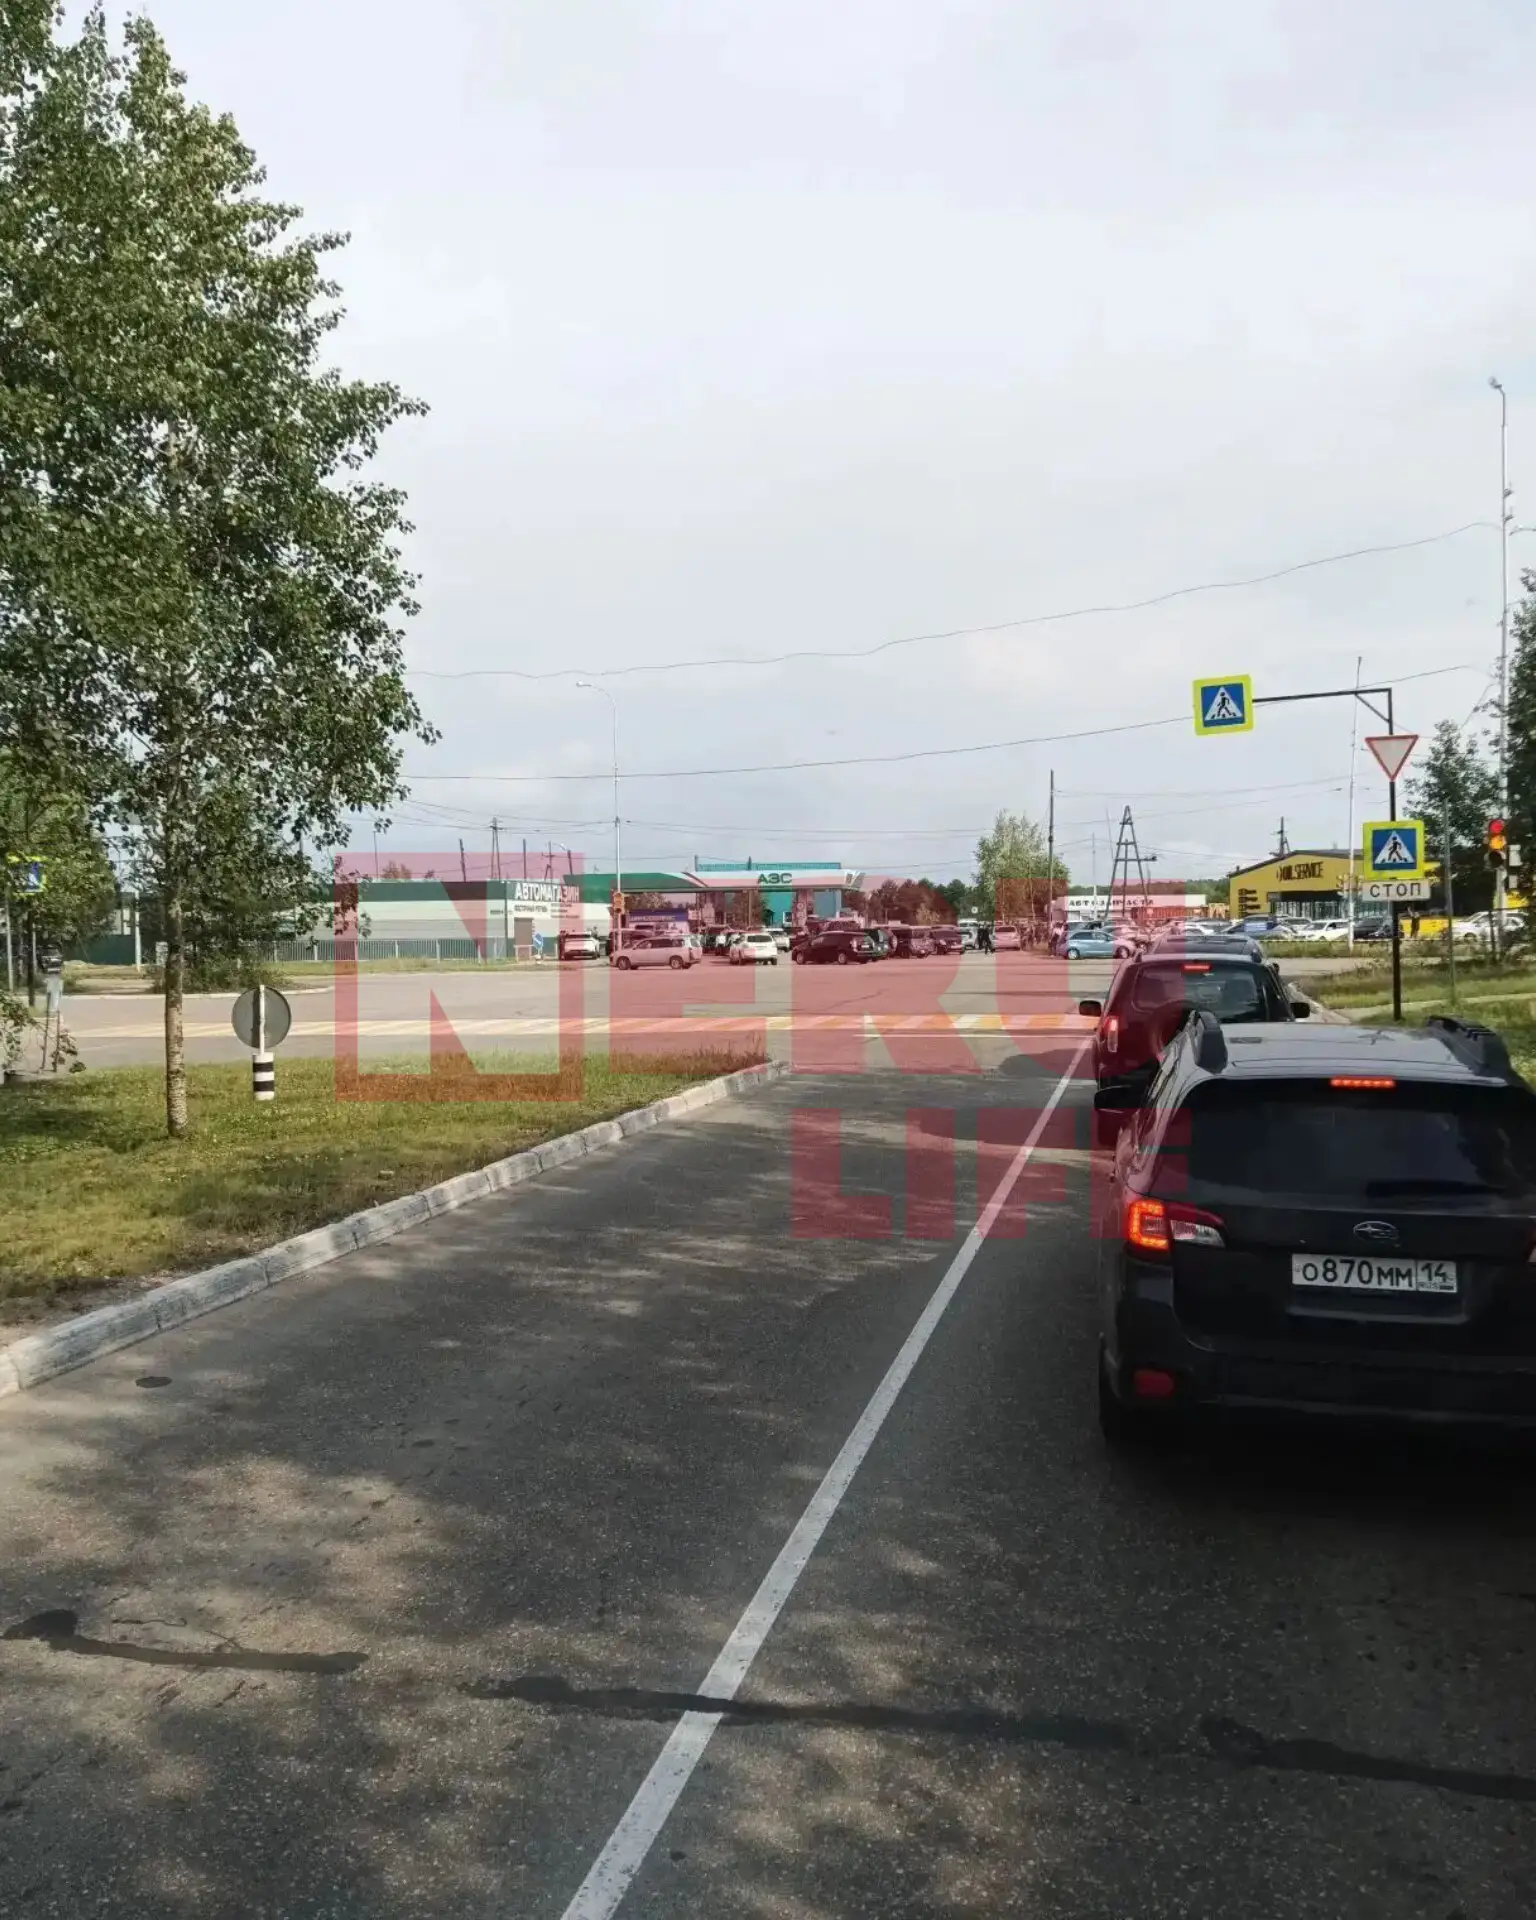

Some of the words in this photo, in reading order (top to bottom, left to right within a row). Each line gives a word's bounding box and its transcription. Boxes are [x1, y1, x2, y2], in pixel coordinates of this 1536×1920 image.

[757, 873, 792, 884] АЗС
[514, 882, 579, 902] АВТОМАГАЗИН
[1370, 882, 1421, 898] СТОП
[1421, 1263, 1446, 1283] 14
